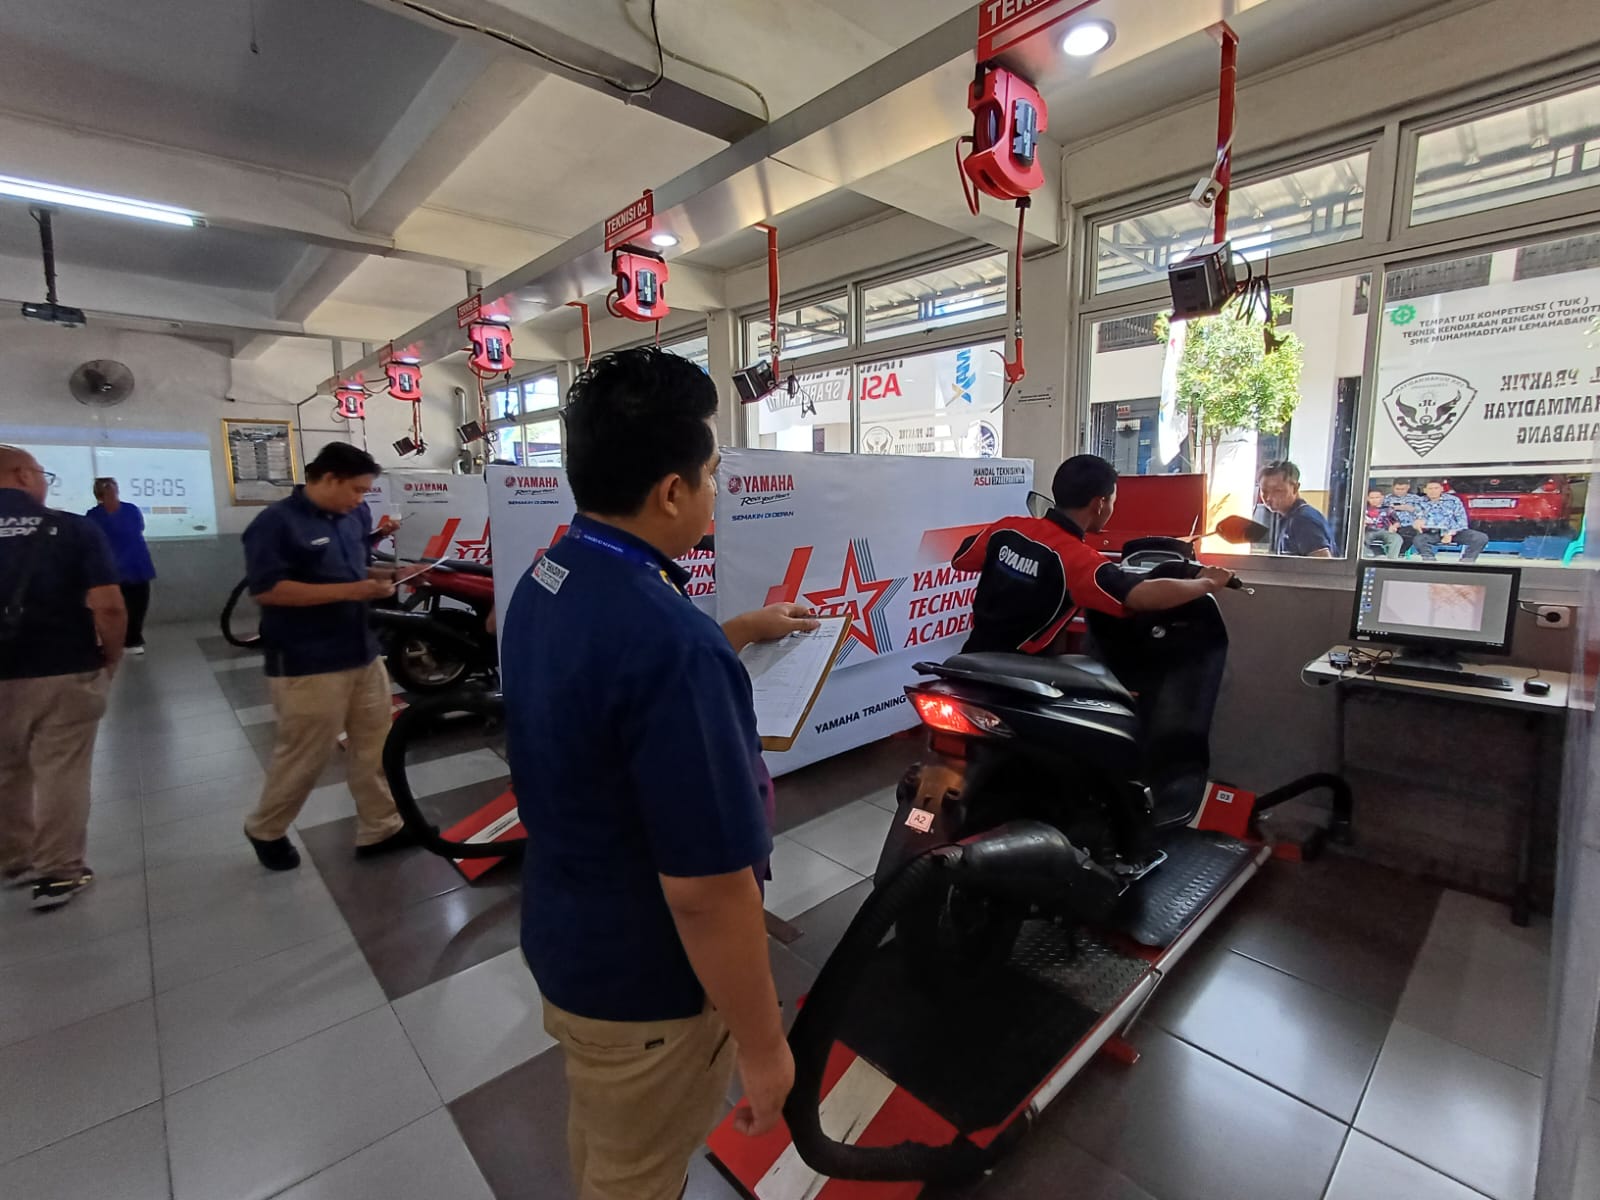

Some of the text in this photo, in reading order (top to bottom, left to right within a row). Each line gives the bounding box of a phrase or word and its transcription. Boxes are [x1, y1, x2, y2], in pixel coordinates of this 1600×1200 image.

[607, 200, 647, 234] TEKNISI 04
[1420, 316, 1456, 328] TEMPAT
[1459, 313, 1474, 323] UJI
[1477, 302, 1547, 319] KOMPETENSI
[1559, 297, 1581, 307] TUK
[1403, 327, 1436, 339] TEKNIK
[1438, 318, 1499, 334] KENDARAAN
[1501, 312, 1544, 326] RINGAN
[1409, 337, 1430, 346] SMK
[1432, 325, 1516, 343] MUHAMMADIYAH
[130, 478, 187, 497] 58:05
[517, 476, 559, 488] YAMAHA
[743, 474, 794, 493] YAMAHA
[974, 476, 991, 486] ASLI
[815, 694, 907, 735] YAMAHA TRAINING
[914, 814, 927, 825] A2
